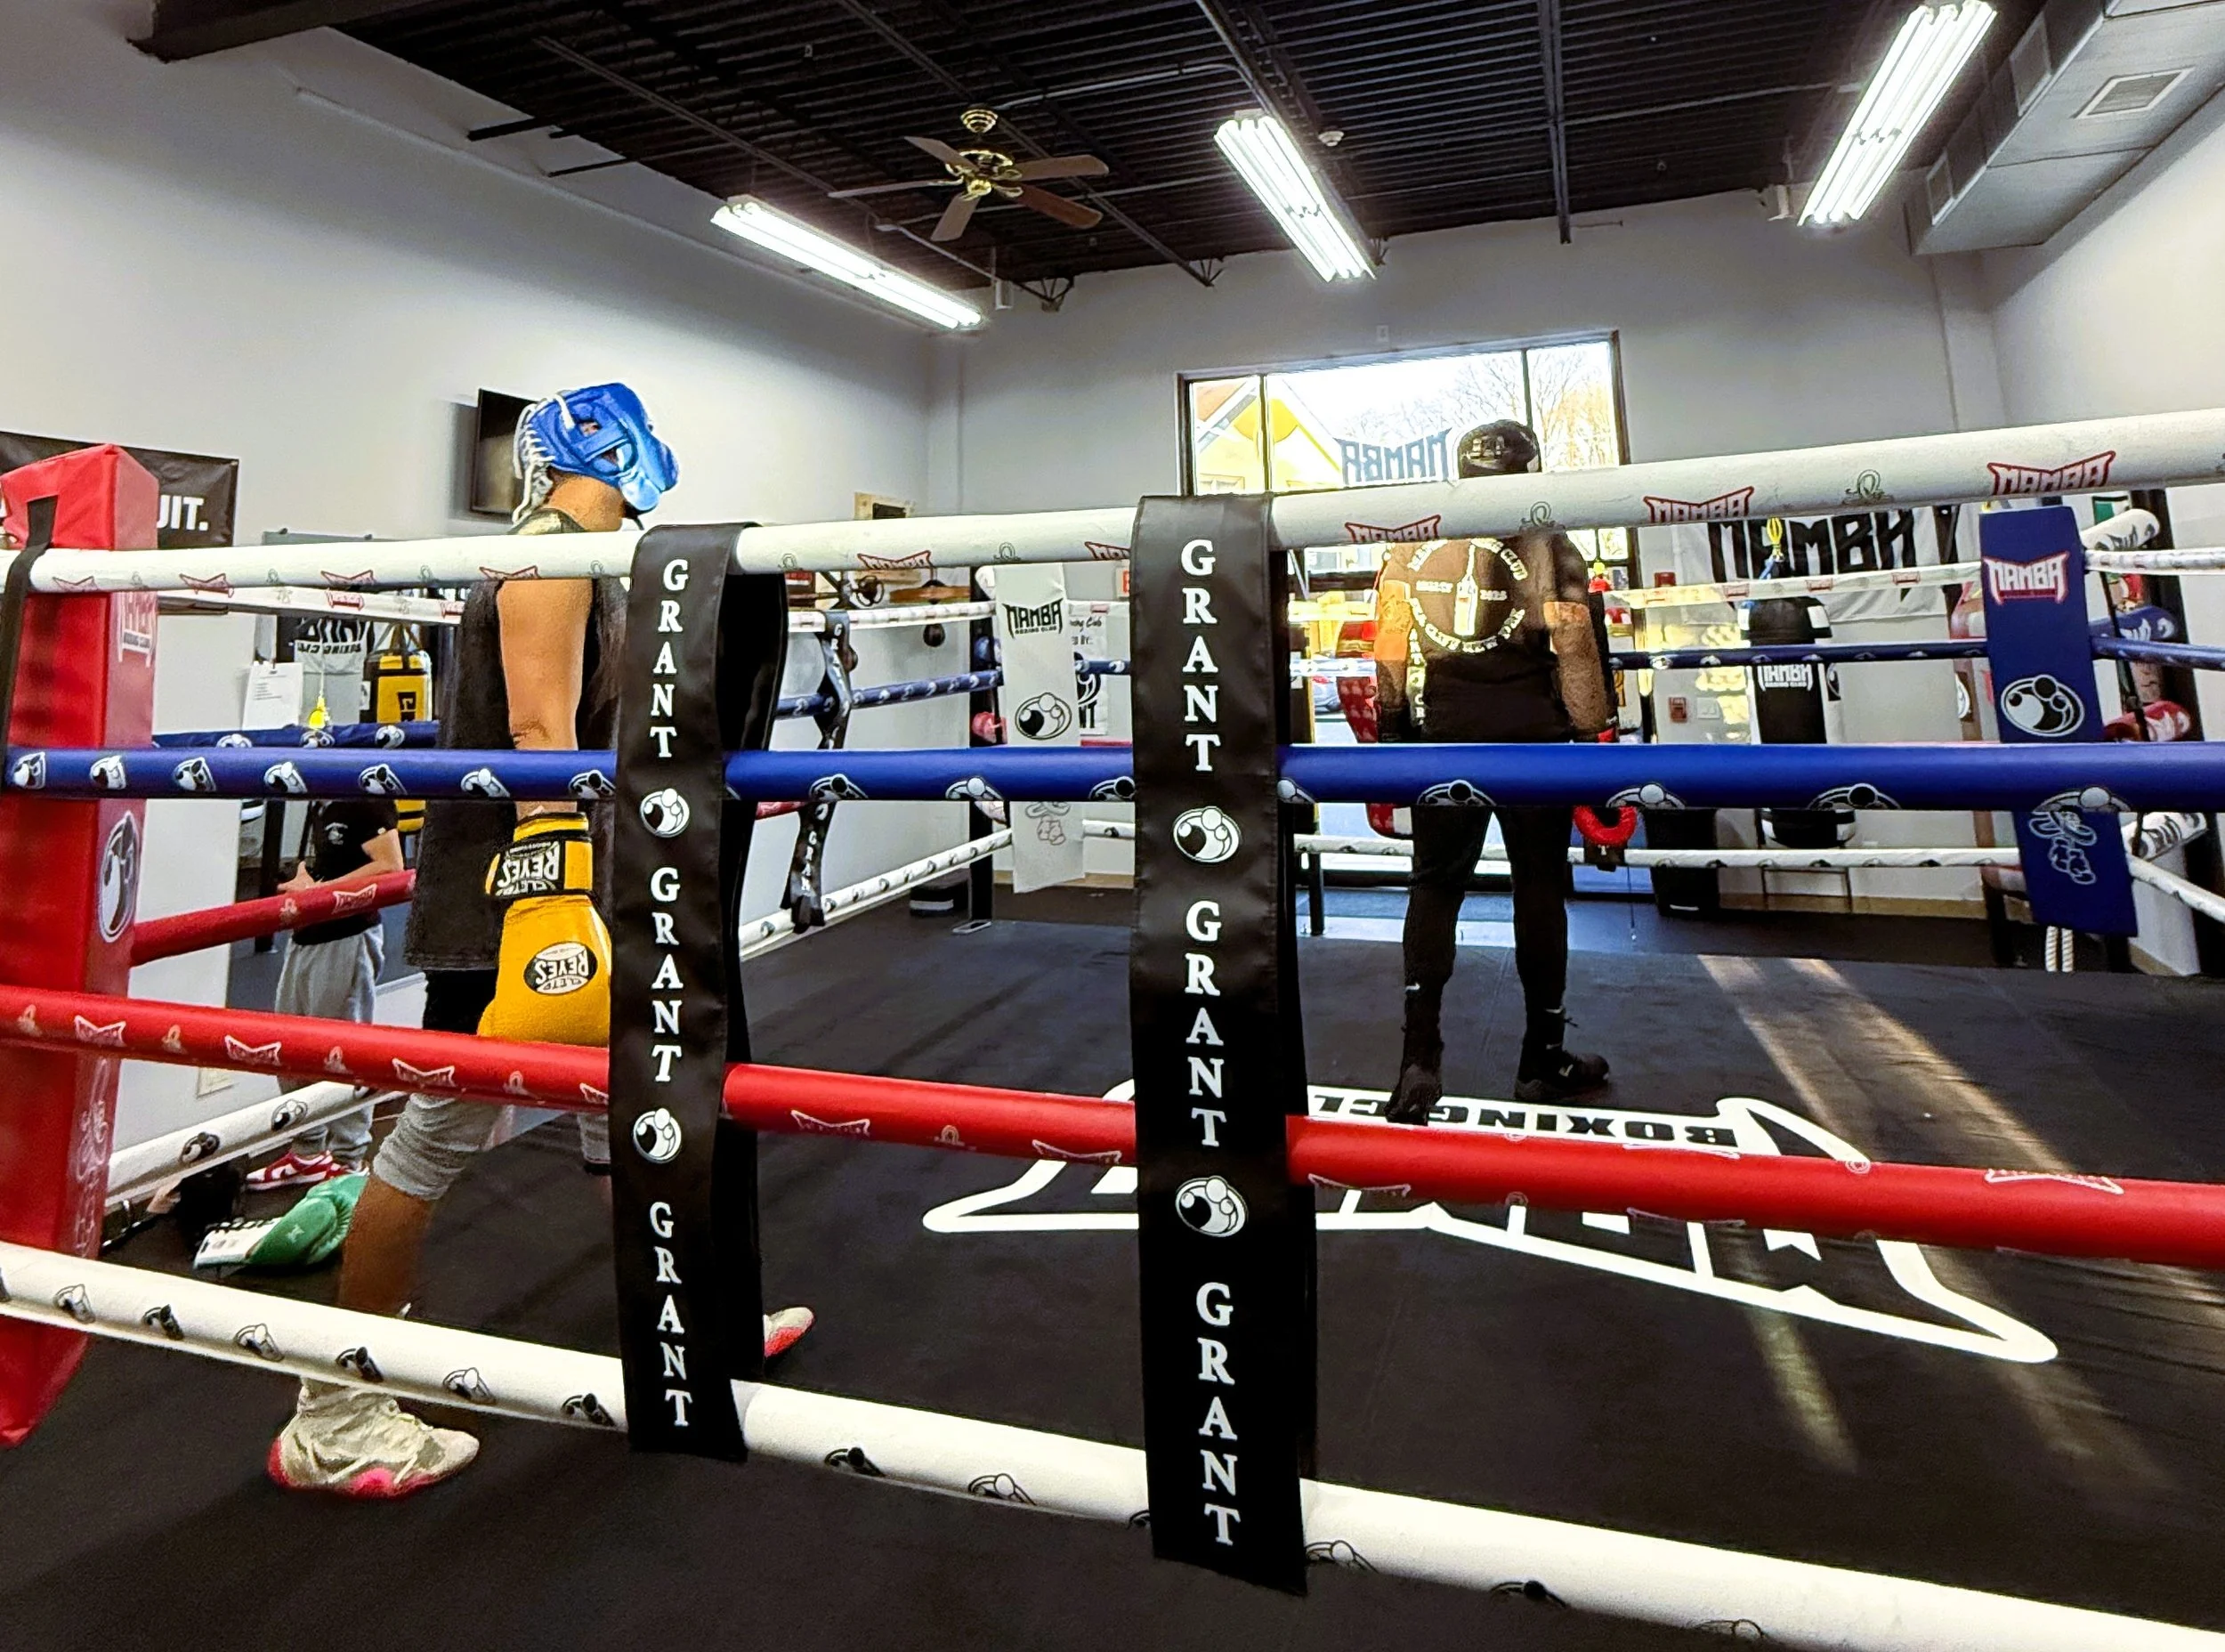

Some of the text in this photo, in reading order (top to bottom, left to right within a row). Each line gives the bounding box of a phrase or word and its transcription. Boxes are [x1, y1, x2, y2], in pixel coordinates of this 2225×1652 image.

[1987, 450, 2116, 495] MAMBA
[1002, 598, 1064, 639] MAMBA
[1982, 551, 2070, 604] MAMBA
[651, 557, 689, 758] GRANT
[1180, 539, 1222, 773] GRANT
[496, 841, 561, 888] REYES
[534, 945, 589, 984] REYES
[650, 866, 684, 1083] GRANT
[1185, 899, 1226, 1147] GRANT
[1313, 1094, 1739, 1148] BOXING CL
[650, 1202, 693, 1427] GRANT
[1196, 1282, 1242, 1547] GRANT
